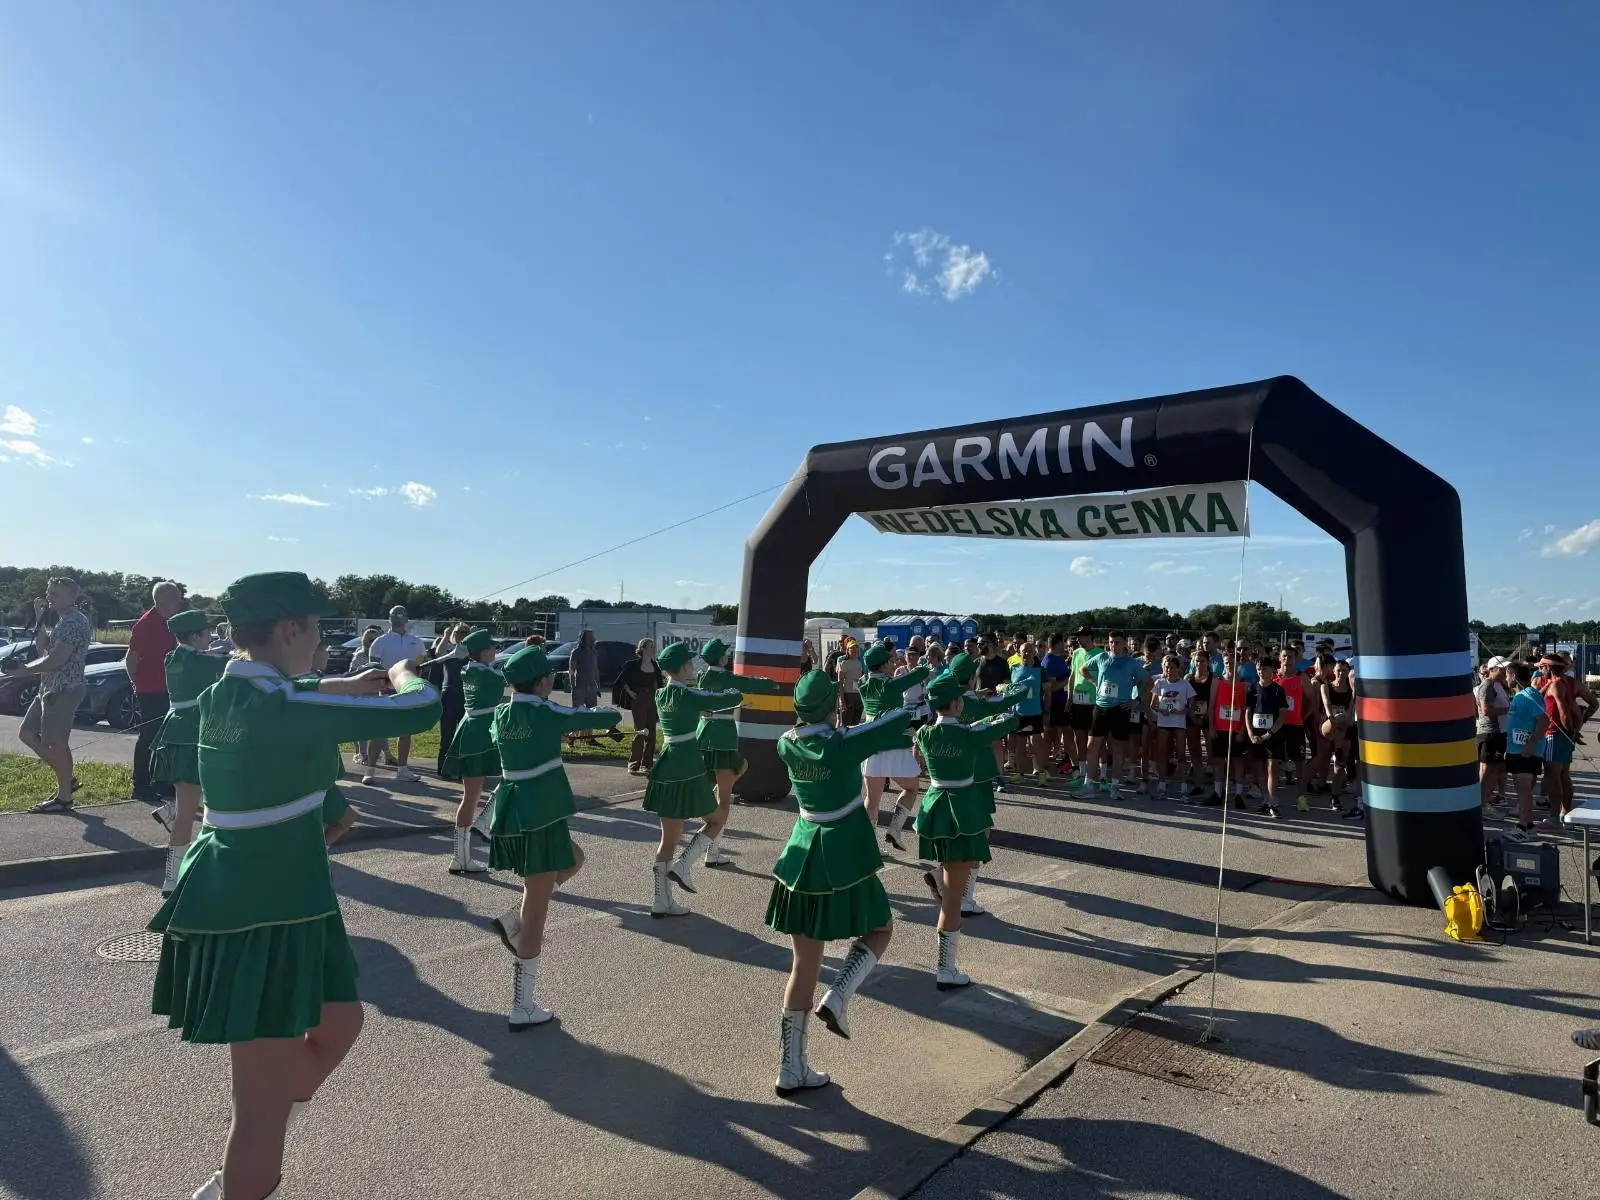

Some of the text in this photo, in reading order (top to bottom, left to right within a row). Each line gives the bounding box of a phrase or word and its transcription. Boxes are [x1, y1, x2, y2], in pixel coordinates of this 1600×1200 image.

[868, 416, 1135, 490] GARMIN
[871, 492, 1240, 539] NEDELSKA CENKA
